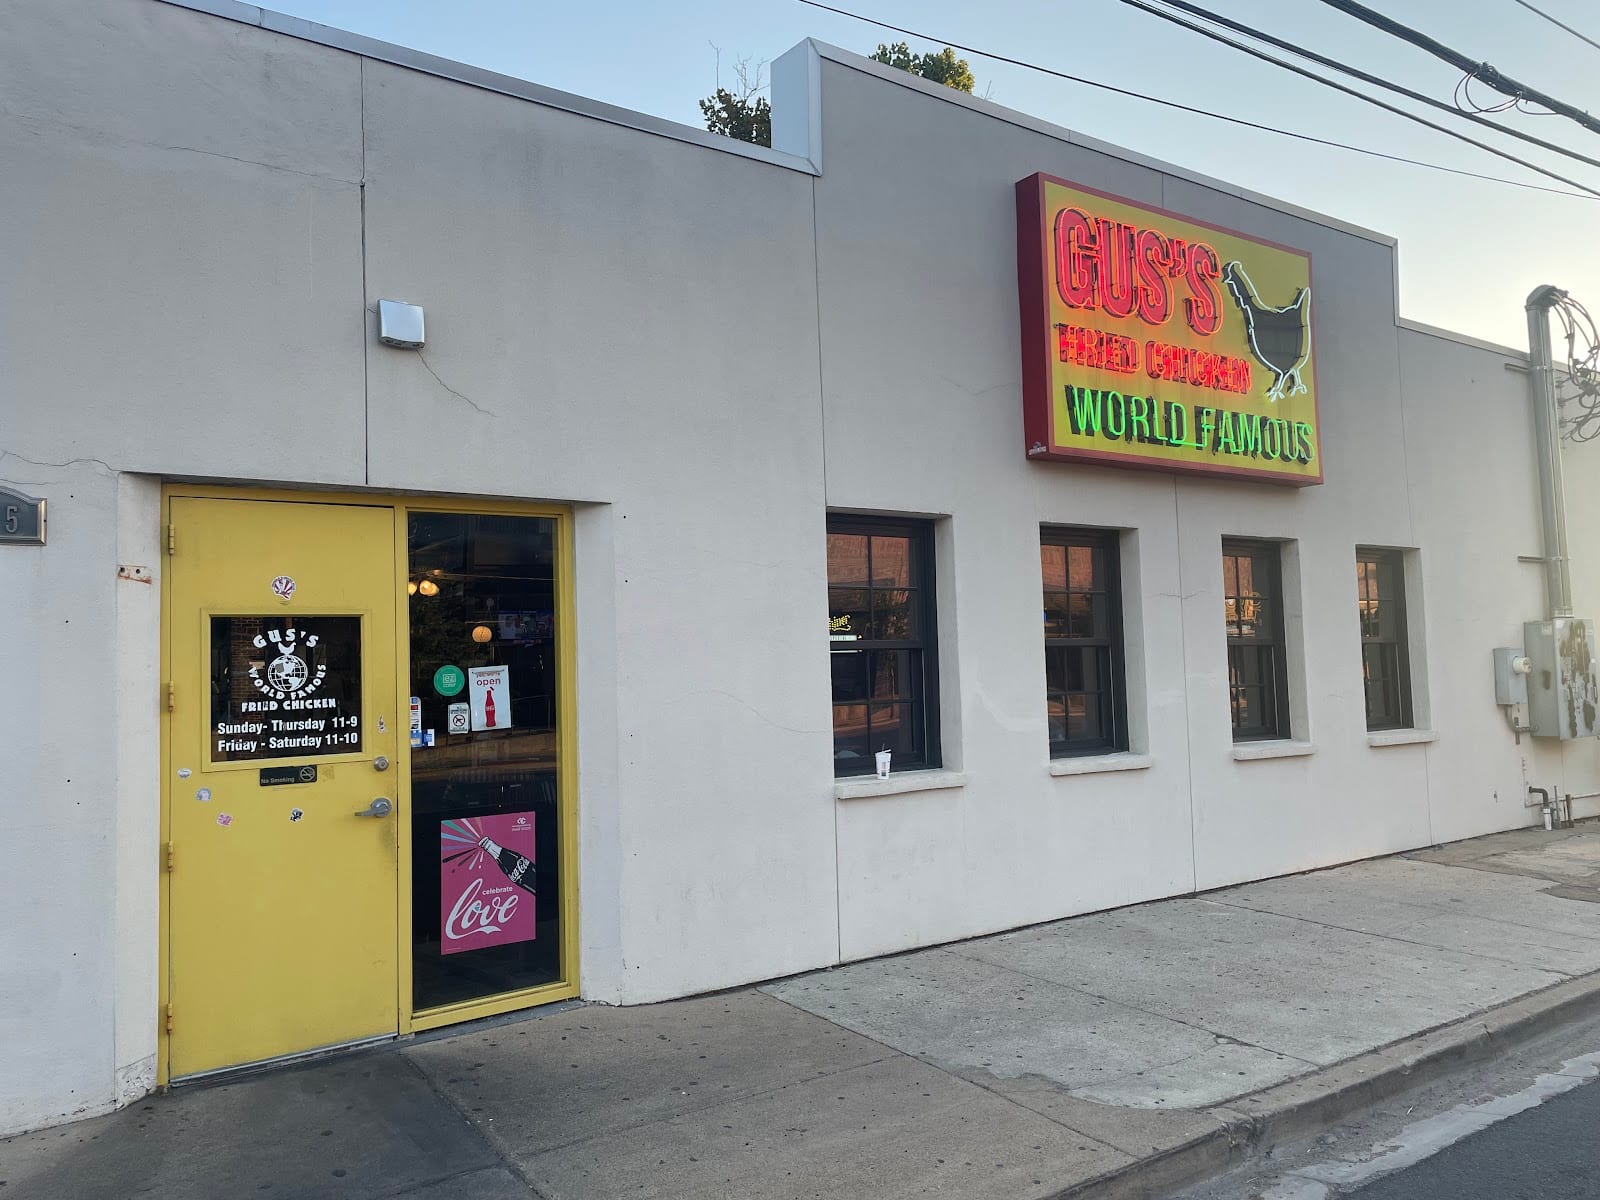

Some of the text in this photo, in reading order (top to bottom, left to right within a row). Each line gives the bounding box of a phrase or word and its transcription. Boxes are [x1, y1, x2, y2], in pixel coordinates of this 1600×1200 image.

[1054, 207, 1224, 336] GUS'S
[1057, 323, 1252, 395] FRIED CHICKEN
[1064, 384, 1315, 465] WORLD FAMOUS
[5, 505, 18, 533] 5
[253, 628, 319, 648] GUS'S
[248, 664, 327, 700] WORLD FAMOUS
[476, 678, 501, 687] open
[241, 698, 336, 712] FRIED CHICKEN
[271, 718, 326, 732] Thursday
[331, 716, 358, 729] 11-9
[217, 739, 257, 753] Friday
[269, 735, 322, 749] Saturday
[325, 732, 358, 746] 11-10
[270, 776, 295, 785] Smoking
[482, 886, 514, 896] celebrate
